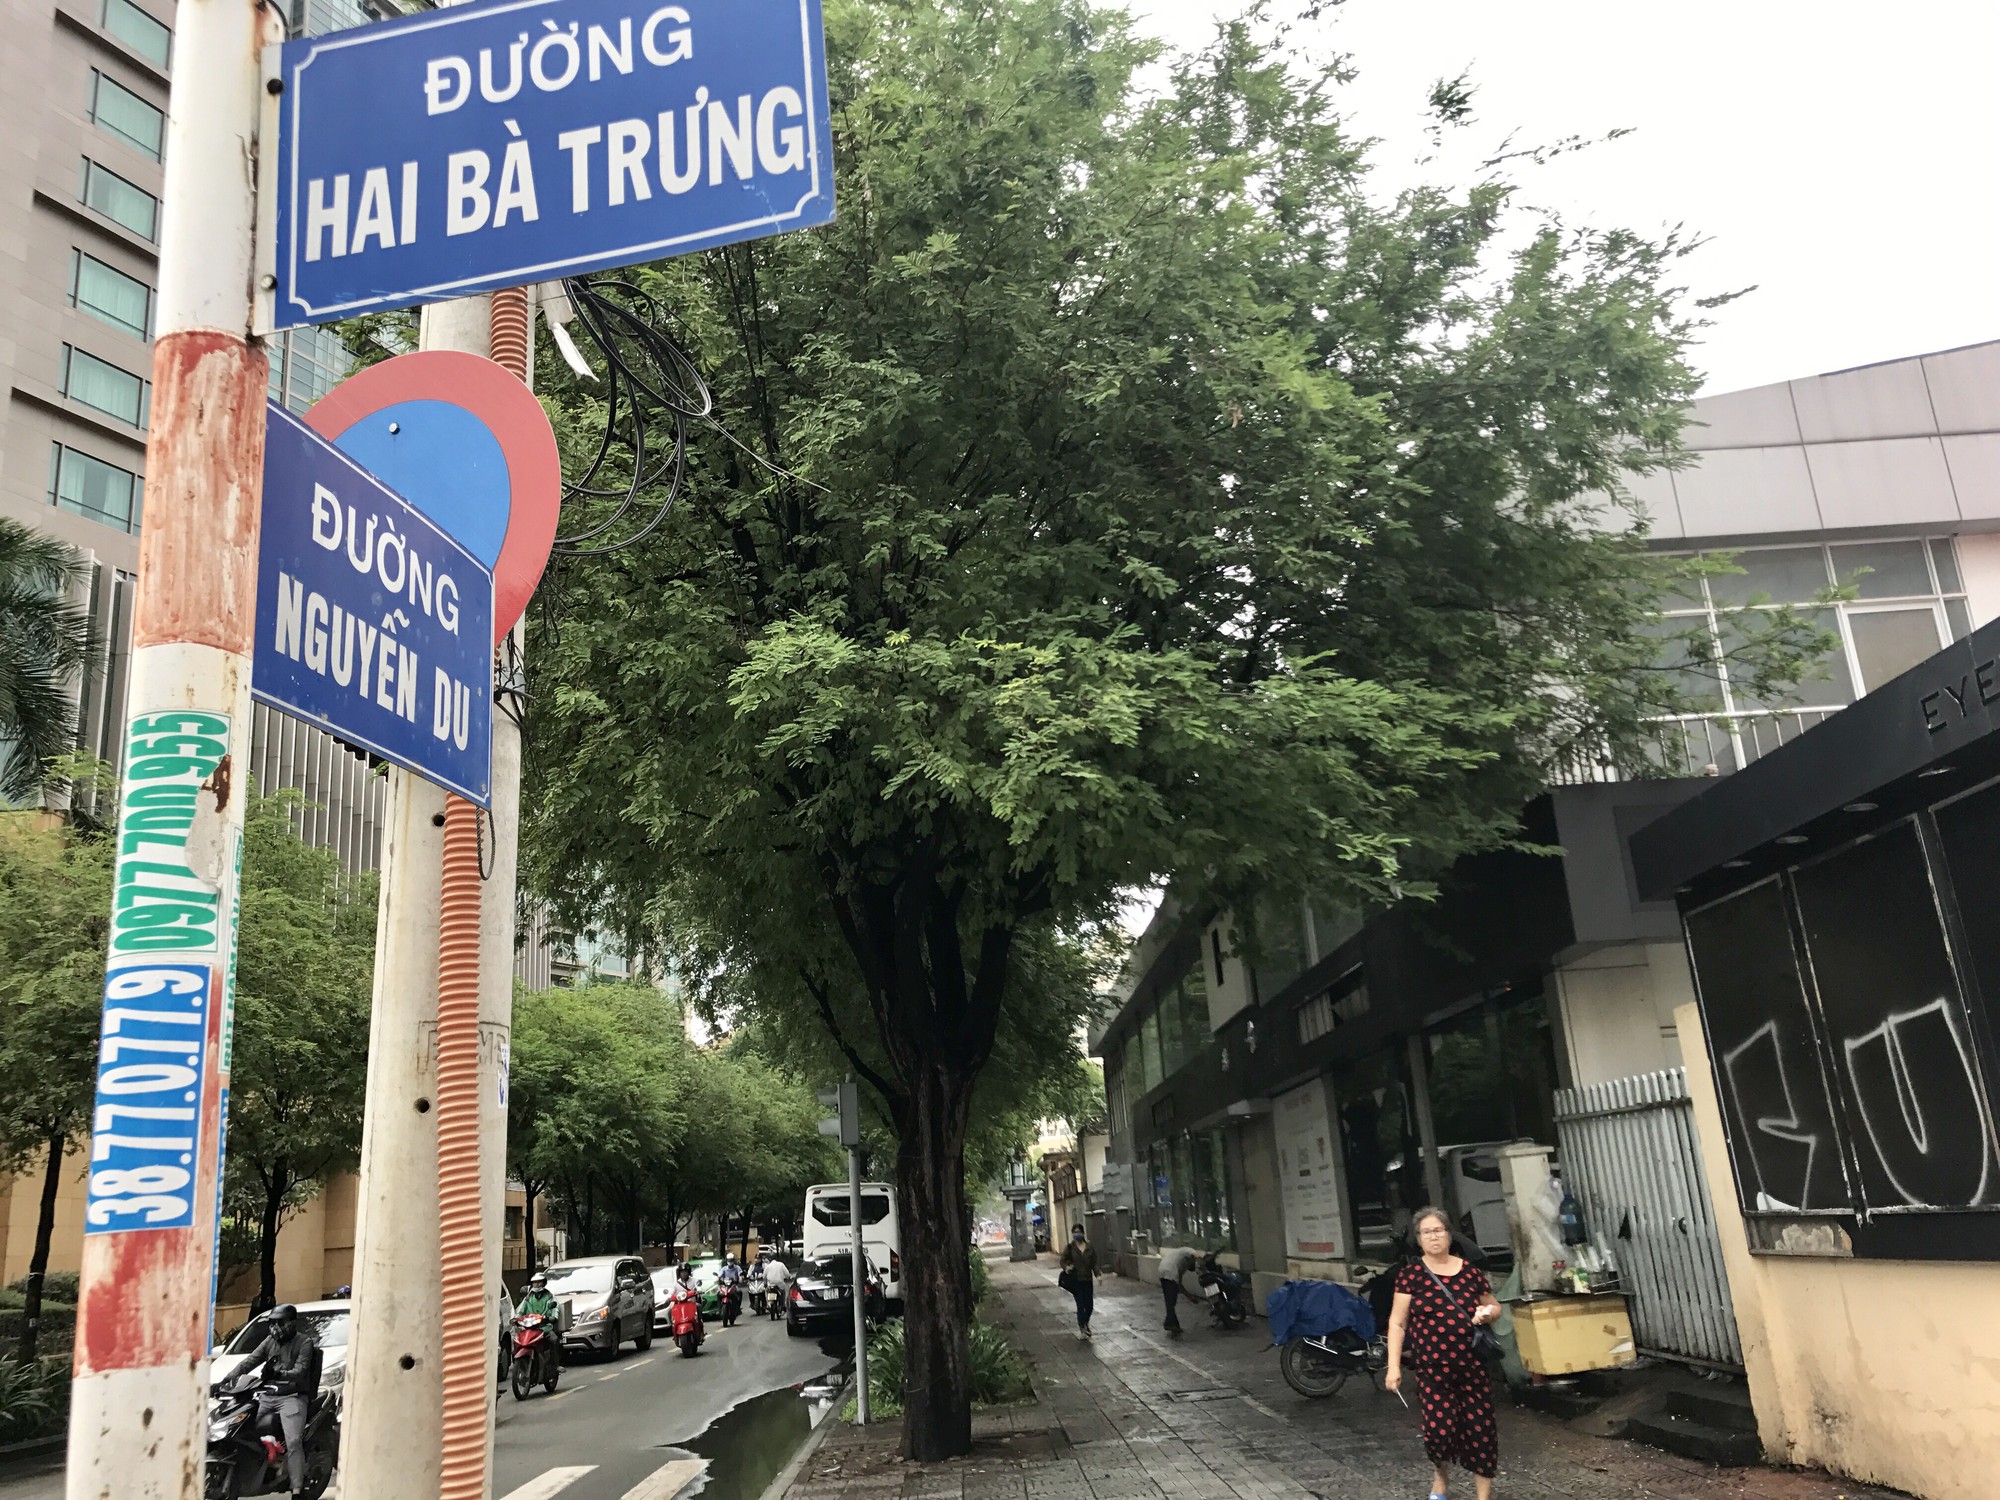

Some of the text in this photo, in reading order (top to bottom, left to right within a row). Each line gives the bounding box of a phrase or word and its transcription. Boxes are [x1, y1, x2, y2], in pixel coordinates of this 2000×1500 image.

[424, 6, 694, 116] ĐƯỜNG
[305, 86, 805, 262] HAI BÀ TRƯNG
[311, 482, 459, 636] ĐƯỜNG
[275, 571, 470, 751] NGUYỄN DU
[127, 713, 228, 781] 955
[88, 969, 205, 1226] 38.77.0.77.9
